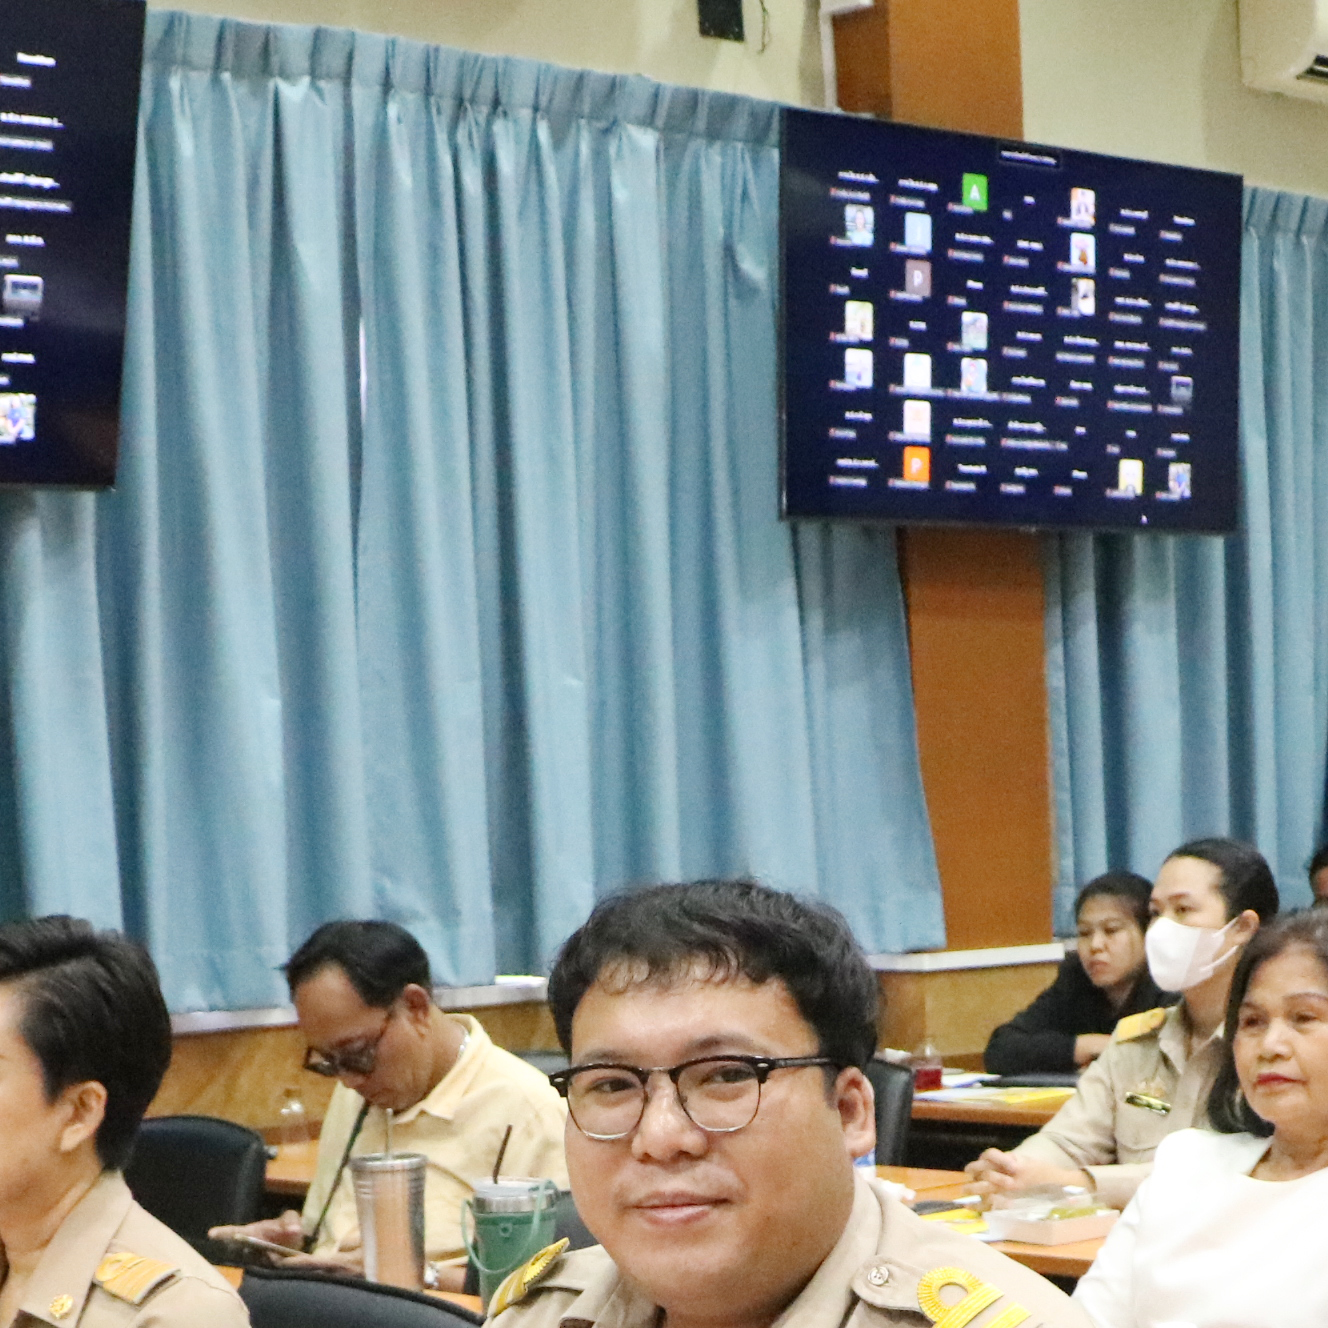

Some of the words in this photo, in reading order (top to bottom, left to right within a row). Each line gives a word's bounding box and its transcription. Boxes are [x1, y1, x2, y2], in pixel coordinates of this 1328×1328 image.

[970, 184, 980, 200] A
[913, 269, 924, 287] P
[911, 458, 923, 473] P
